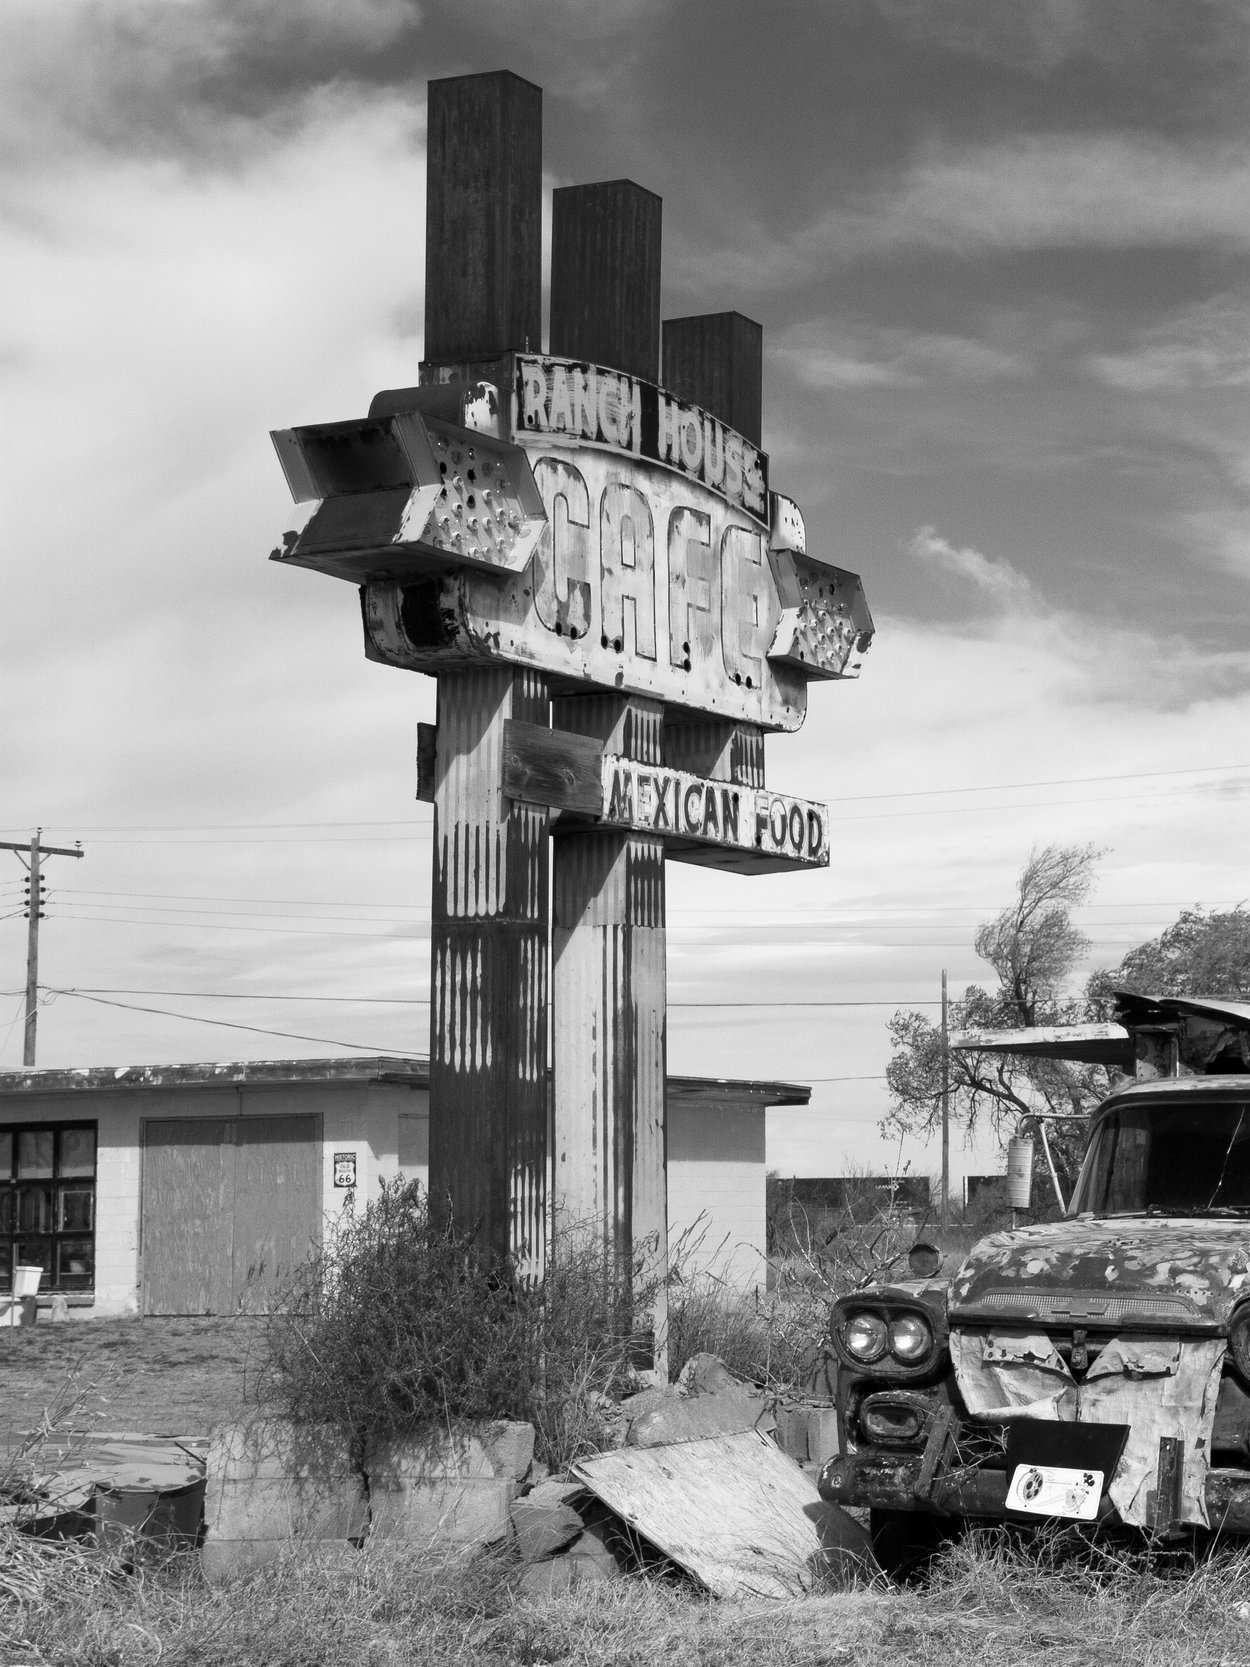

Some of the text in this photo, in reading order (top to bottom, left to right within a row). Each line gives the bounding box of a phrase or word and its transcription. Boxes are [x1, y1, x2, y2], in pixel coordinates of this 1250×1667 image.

[521, 362, 641, 456] RANCH
[533, 457, 763, 690] CAFE
[608, 769, 823, 858] MEXICAN FOOD
[338, 1174, 352, 1183] 66
